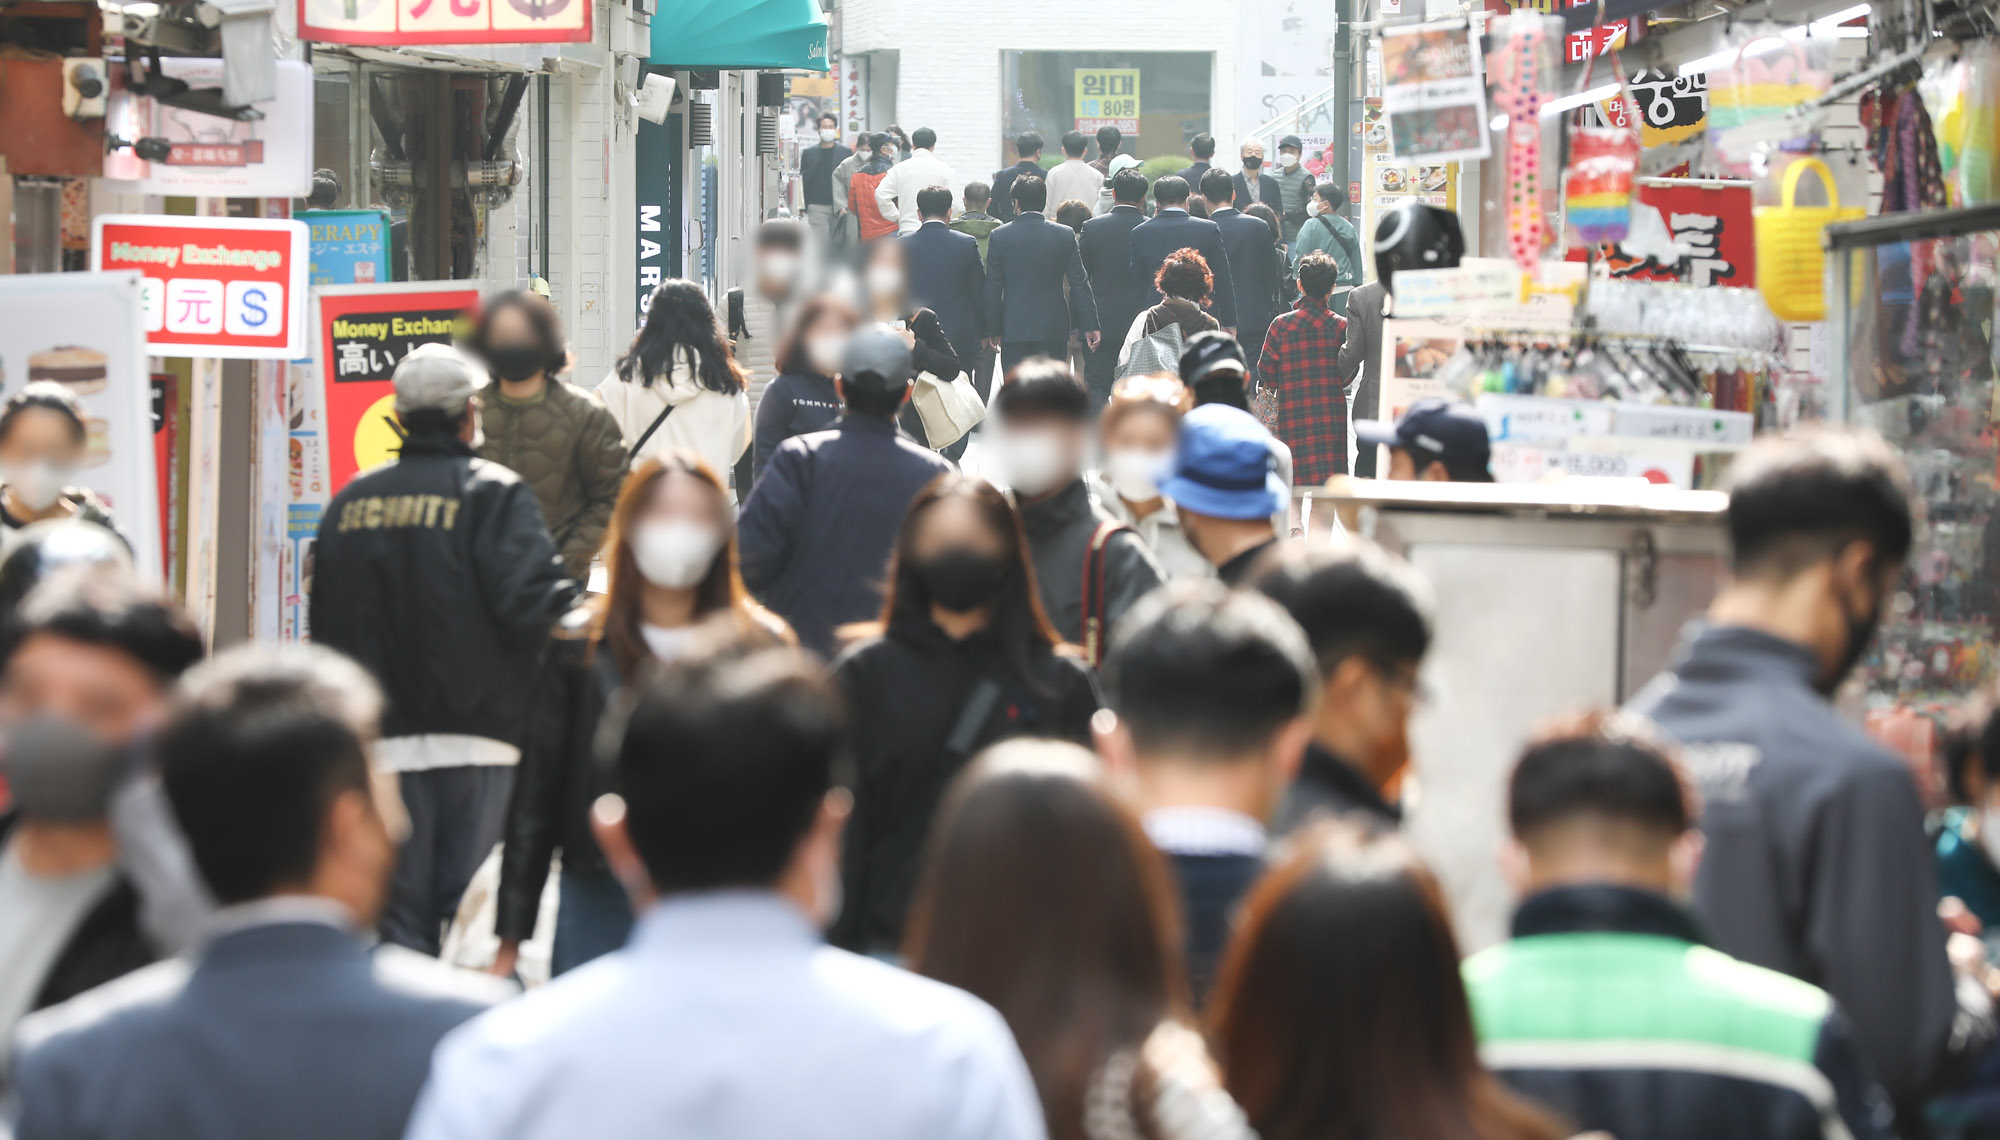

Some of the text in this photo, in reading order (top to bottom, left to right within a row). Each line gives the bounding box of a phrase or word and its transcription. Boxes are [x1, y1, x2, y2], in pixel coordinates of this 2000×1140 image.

[1082, 74, 1134, 96] 임대
[1103, 100, 1135, 117] 80평
[311, 224, 381, 242] ERAPY
[110, 243, 180, 268] Money
[182, 245, 282, 271] Exchange
[640, 205, 662, 328] MARS
[177, 290, 212, 325] 元
[332, 317, 472, 342] Money Exchan
[336, 341, 415, 377] 高い
[792, 398, 828, 409] TOMMY
[337, 493, 460, 533] SECURITY
